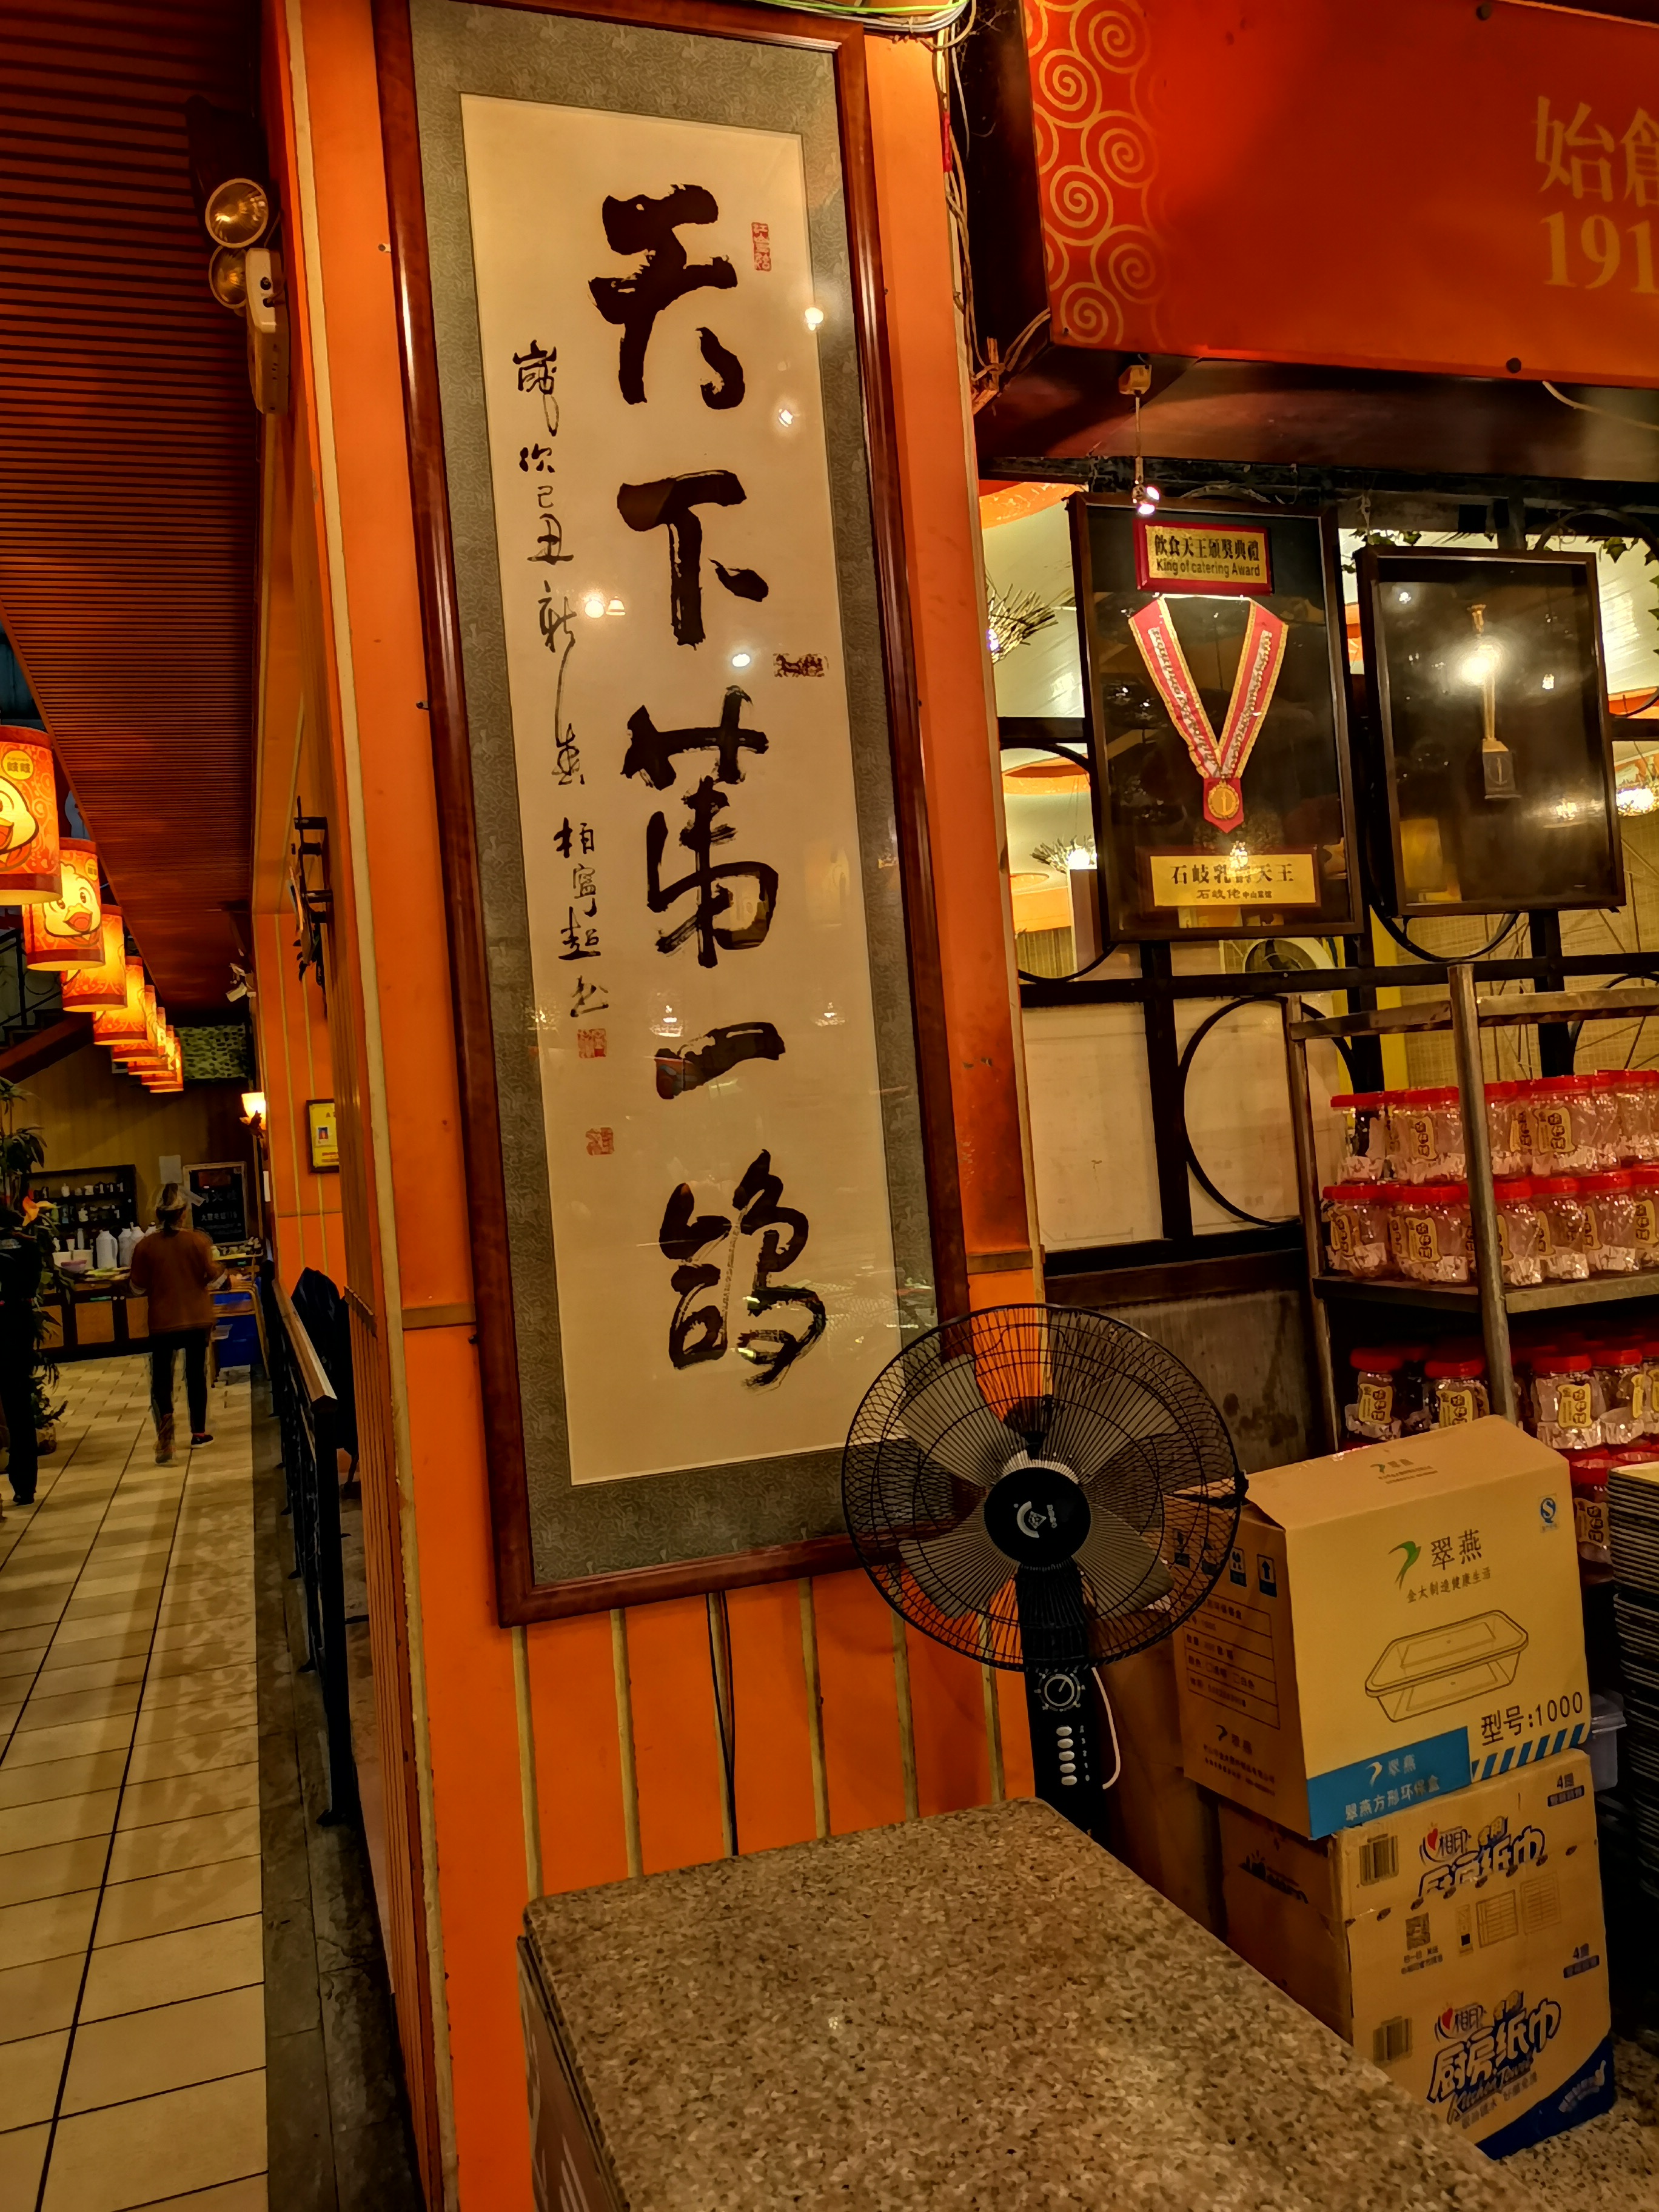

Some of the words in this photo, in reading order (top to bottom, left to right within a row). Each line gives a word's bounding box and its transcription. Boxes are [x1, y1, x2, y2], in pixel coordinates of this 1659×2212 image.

[1156, 558, 1179, 576] King
[1180, 560, 1190, 573] of
[1191, 562, 1230, 578] catering
[1231, 562, 1261, 577] Award
[1430, 1528, 1483, 1571] 翠燕
[1481, 1691, 1583, 1746] 型号:1000
[1426, 1997, 1562, 2104] 厨房纸巾
